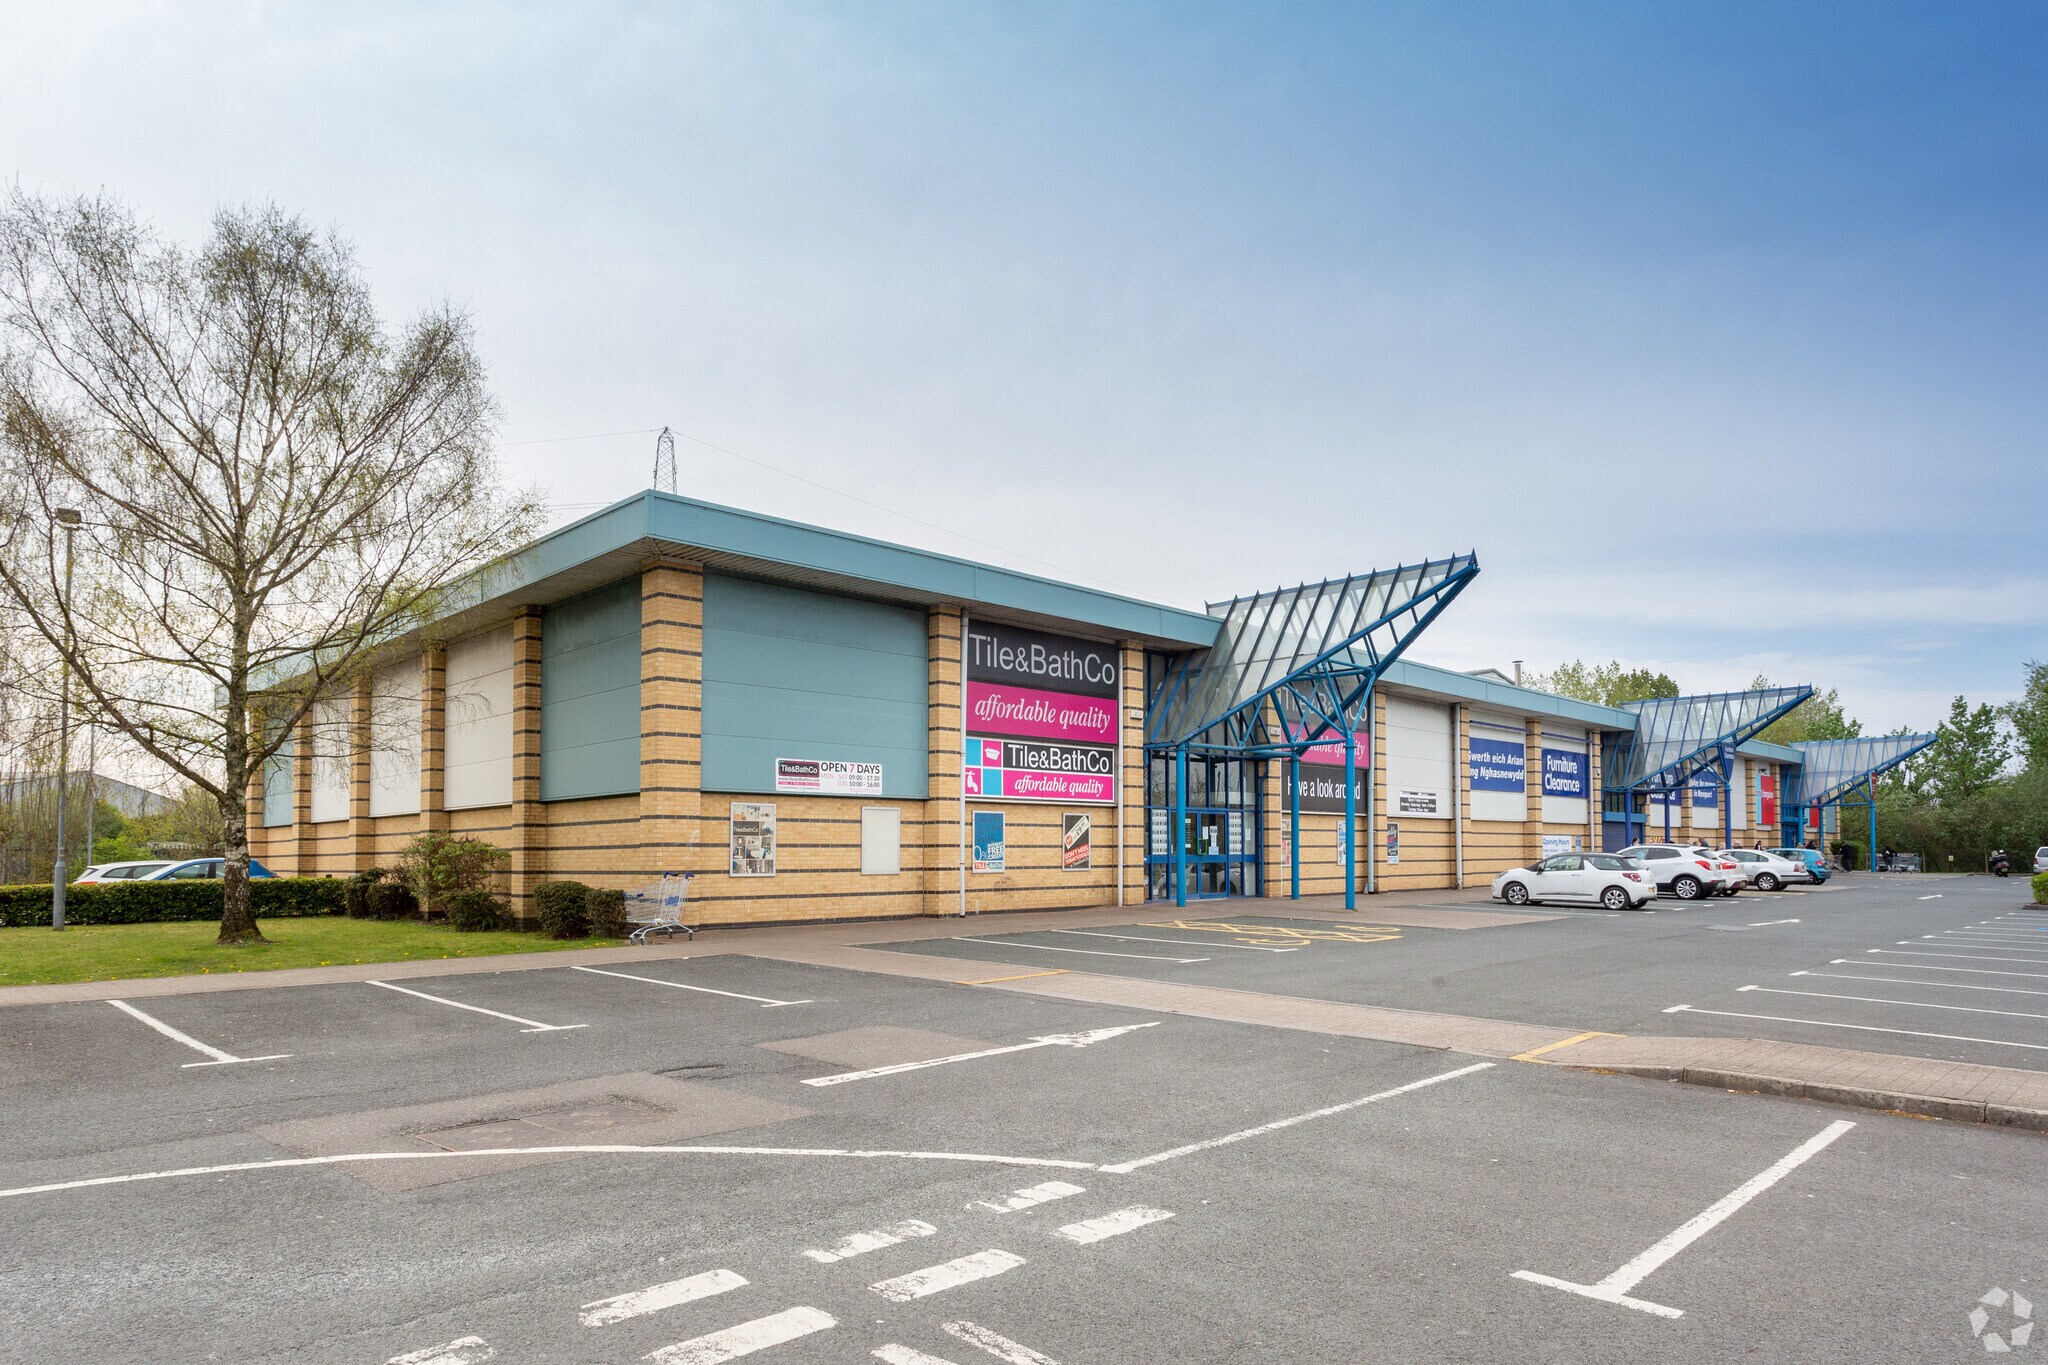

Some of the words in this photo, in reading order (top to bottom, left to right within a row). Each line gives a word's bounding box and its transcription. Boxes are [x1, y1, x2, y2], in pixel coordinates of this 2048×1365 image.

[969, 633, 1115, 685] Tile&BathCo
[974, 694, 1056, 723] affordable
[1059, 706, 1110, 733] quality
[820, 762, 847, 773] OPEN
[848, 763, 855, 773] 7
[856, 764, 880, 774] DAYS
[1007, 744, 1109, 773] Tile&BathCo
[1492, 753, 1506, 765] eich
[1507, 754, 1524, 766] Arian
[1546, 755, 1578, 774] Furniture
[781, 764, 818, 774] Tile&BathCo
[1480, 766, 1524, 782] Nghasnewydd
[1014, 775, 1067, 793] affordable
[1069, 778, 1104, 797] quality
[1287, 775, 1308, 797] Hve
[1310, 782, 1316, 797] a
[1316, 777, 1334, 798] look
[1544, 773, 1580, 793] Clearance
[987, 845, 1004, 854] FREE
